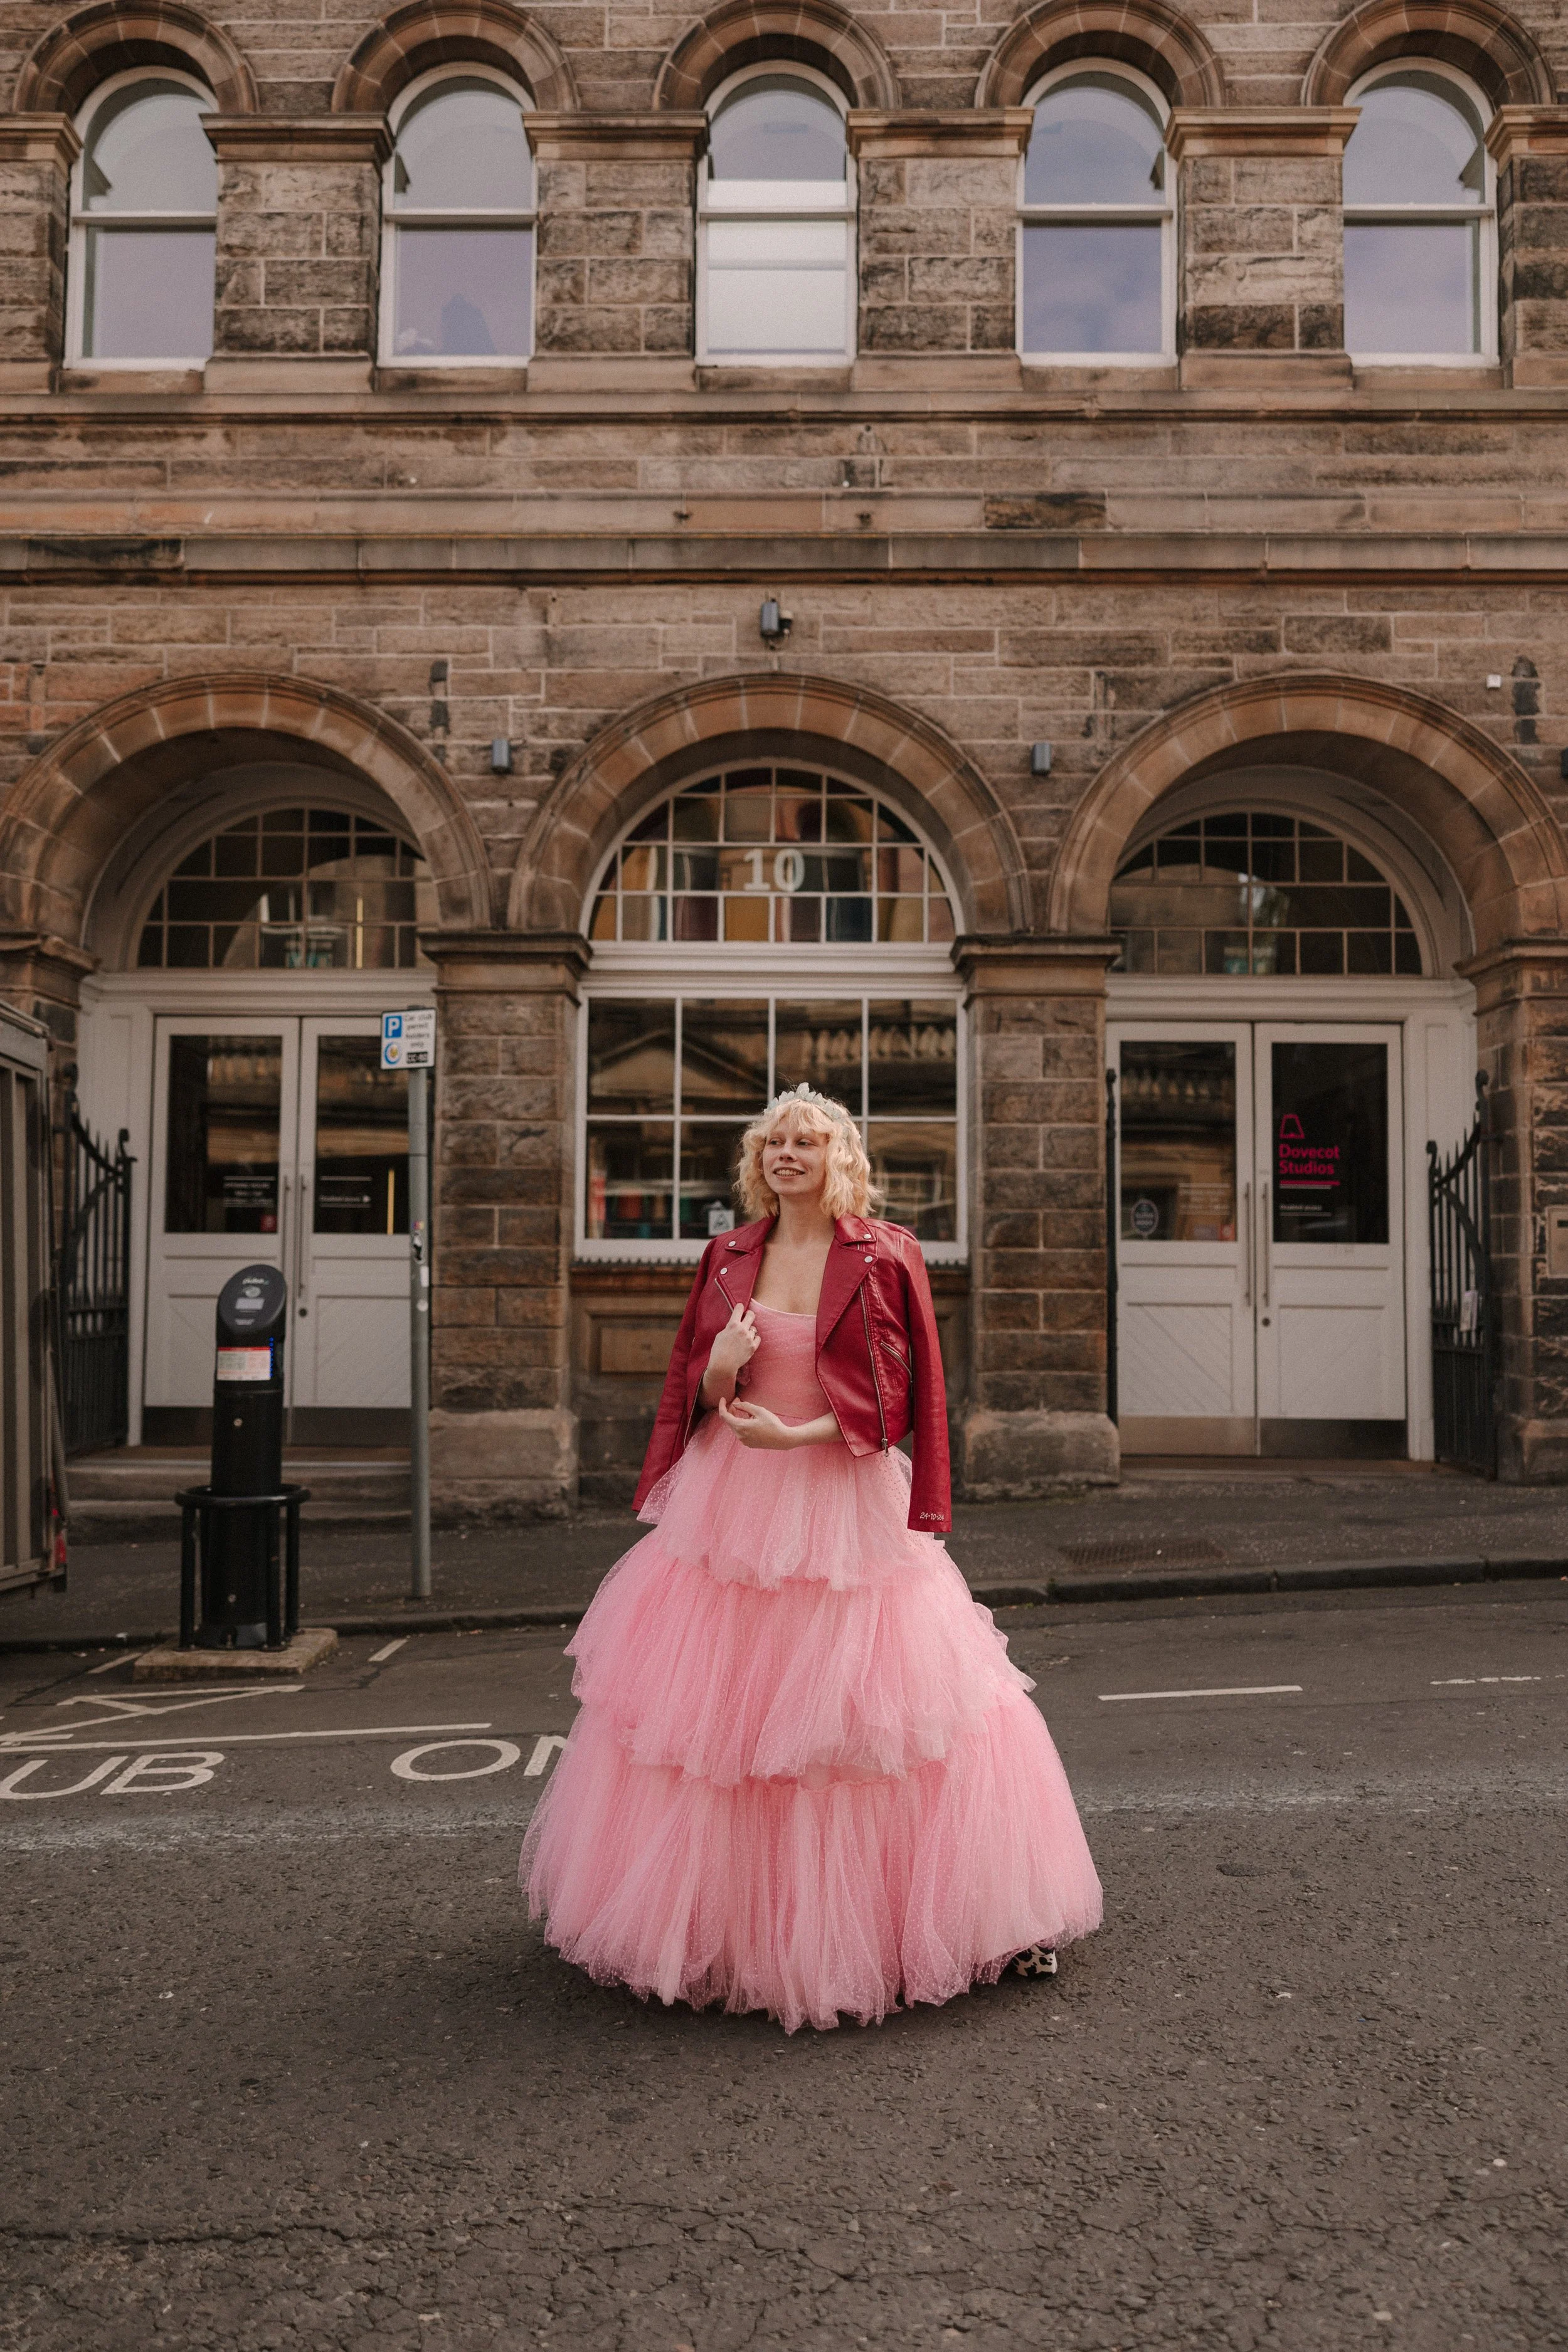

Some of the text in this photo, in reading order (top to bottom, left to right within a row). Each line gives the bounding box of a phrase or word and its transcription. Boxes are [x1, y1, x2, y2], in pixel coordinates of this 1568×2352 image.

[743, 848, 805, 892] 10
[388, 1017, 400, 1037] P
[1279, 1143, 1340, 1160] Dovecot
[1279, 1160, 1335, 1175] Studios
